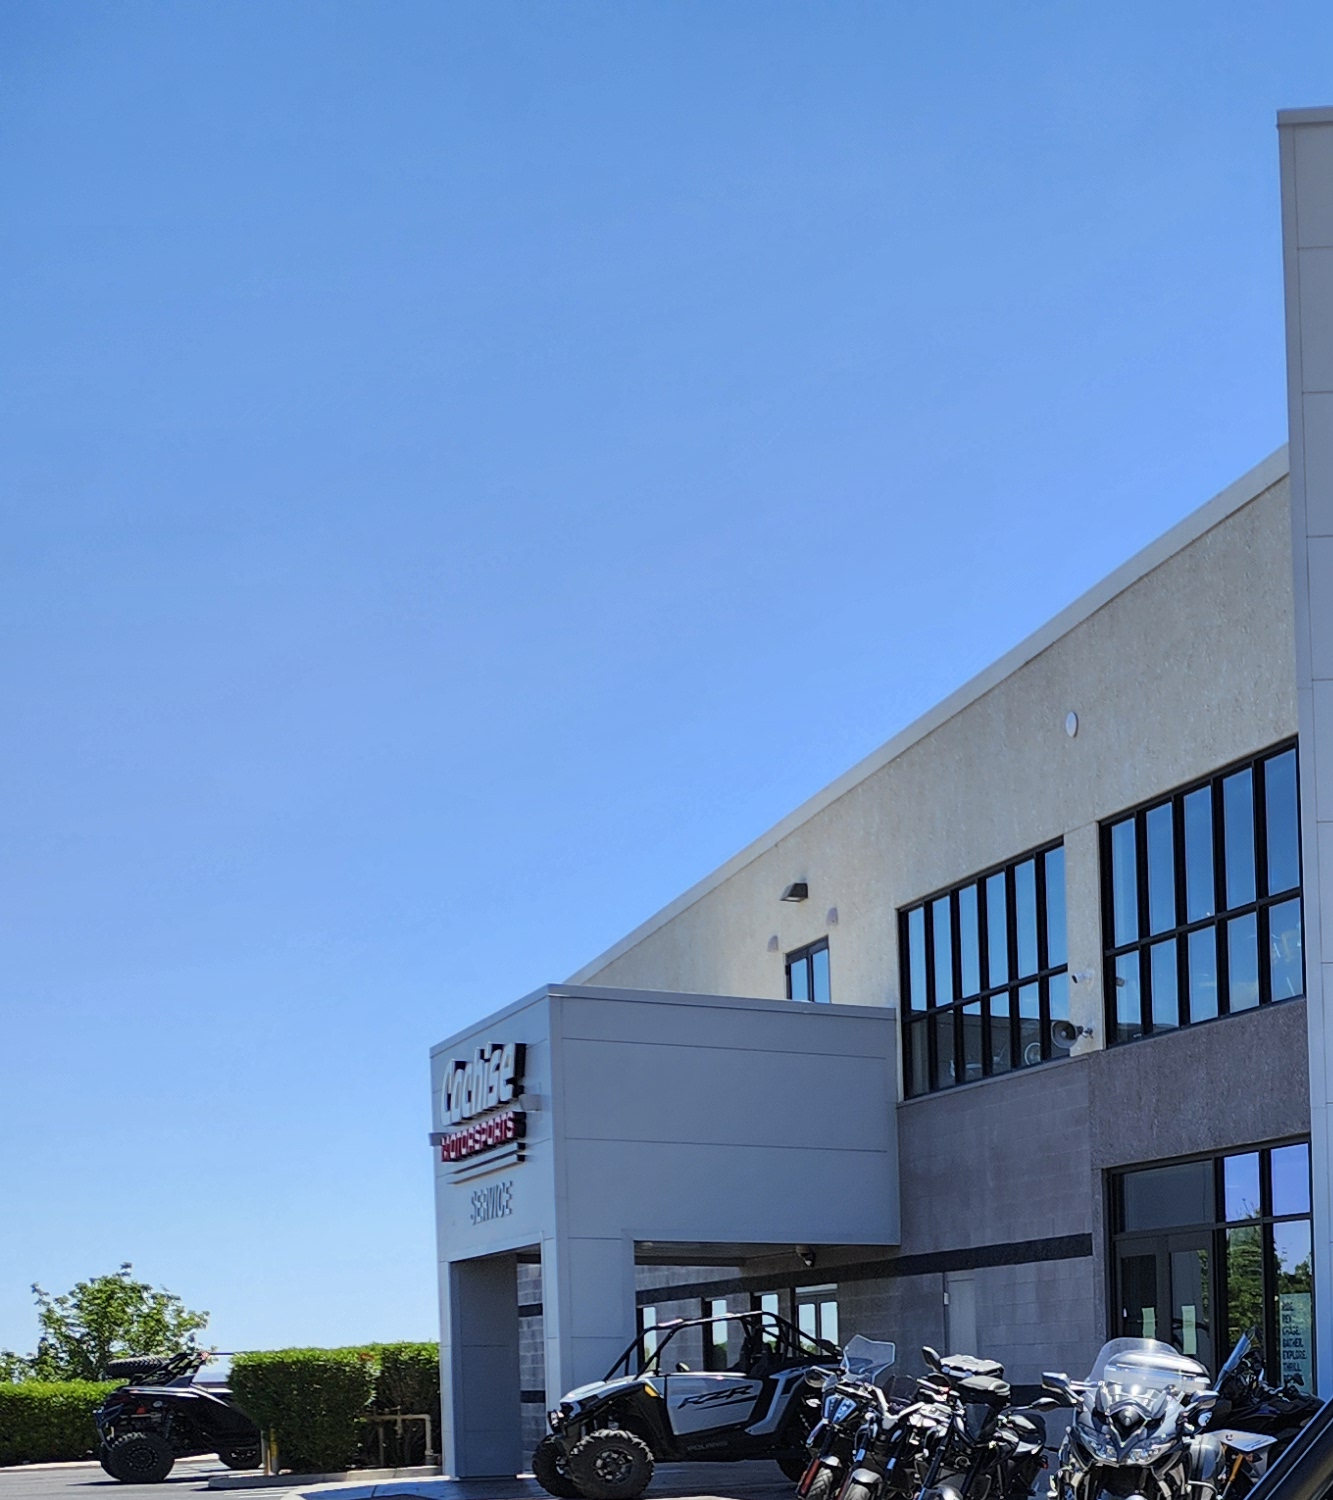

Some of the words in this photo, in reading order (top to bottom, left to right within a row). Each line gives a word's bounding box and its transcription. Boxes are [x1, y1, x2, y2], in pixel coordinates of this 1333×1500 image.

[440, 1041, 522, 1127] Cochise
[441, 1111, 519, 1163] MOTORSPORTS
[469, 1179, 514, 1226] SERVICE
[676, 1384, 754, 1410] RZR
